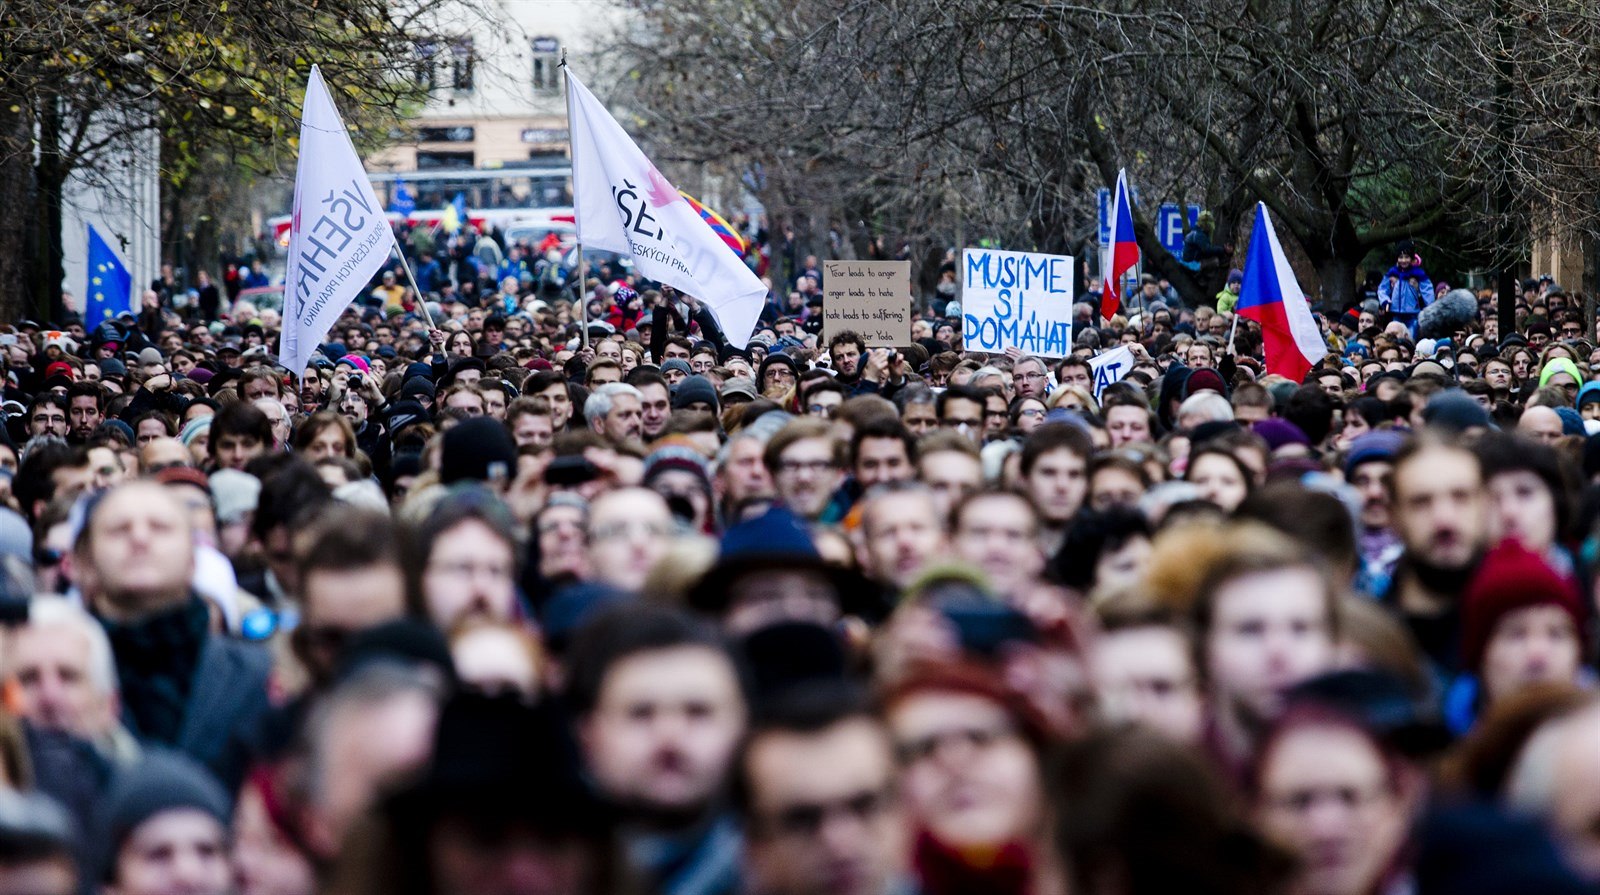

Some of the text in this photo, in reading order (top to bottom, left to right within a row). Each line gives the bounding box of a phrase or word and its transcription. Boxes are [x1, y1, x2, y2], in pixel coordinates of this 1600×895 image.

[630, 241, 670, 265] ESKÝCH
[848, 267, 865, 278] leads
[867, 267, 875, 278] to
[877, 270, 897, 280] anger
[967, 252, 1067, 294] MUSÍME
[828, 287, 895, 300] anger leads to hate
[825, 309, 841, 320] hate
[842, 308, 860, 320] leads
[861, 309, 870, 320] to
[993, 289, 1023, 321] SI
[875, 330, 894, 341] Yoda
[963, 311, 1071, 356] POMÁHAT
